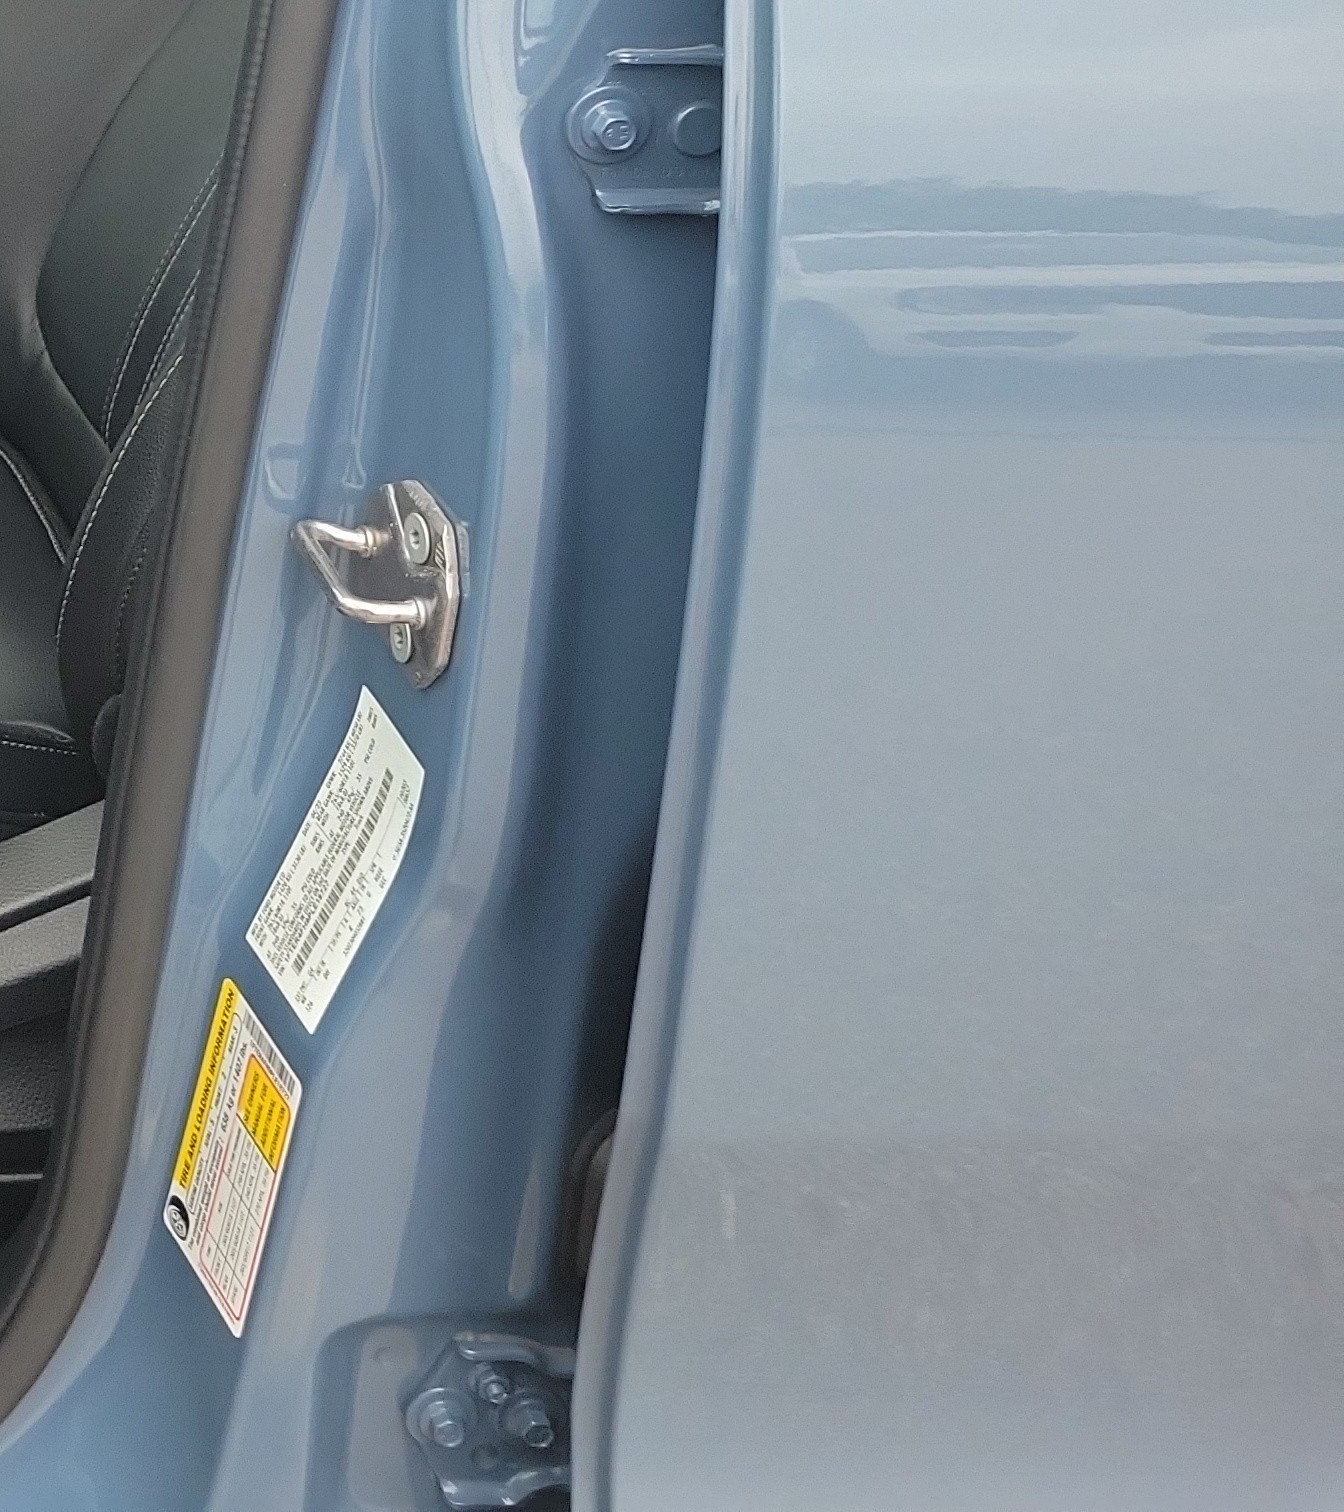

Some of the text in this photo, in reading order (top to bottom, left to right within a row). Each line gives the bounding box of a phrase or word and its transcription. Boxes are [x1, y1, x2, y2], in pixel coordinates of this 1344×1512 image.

[179, 988, 234, 1190] TIRE AND LOADING INFORMATION
[268, 1104, 285, 1163] INFORMATION
